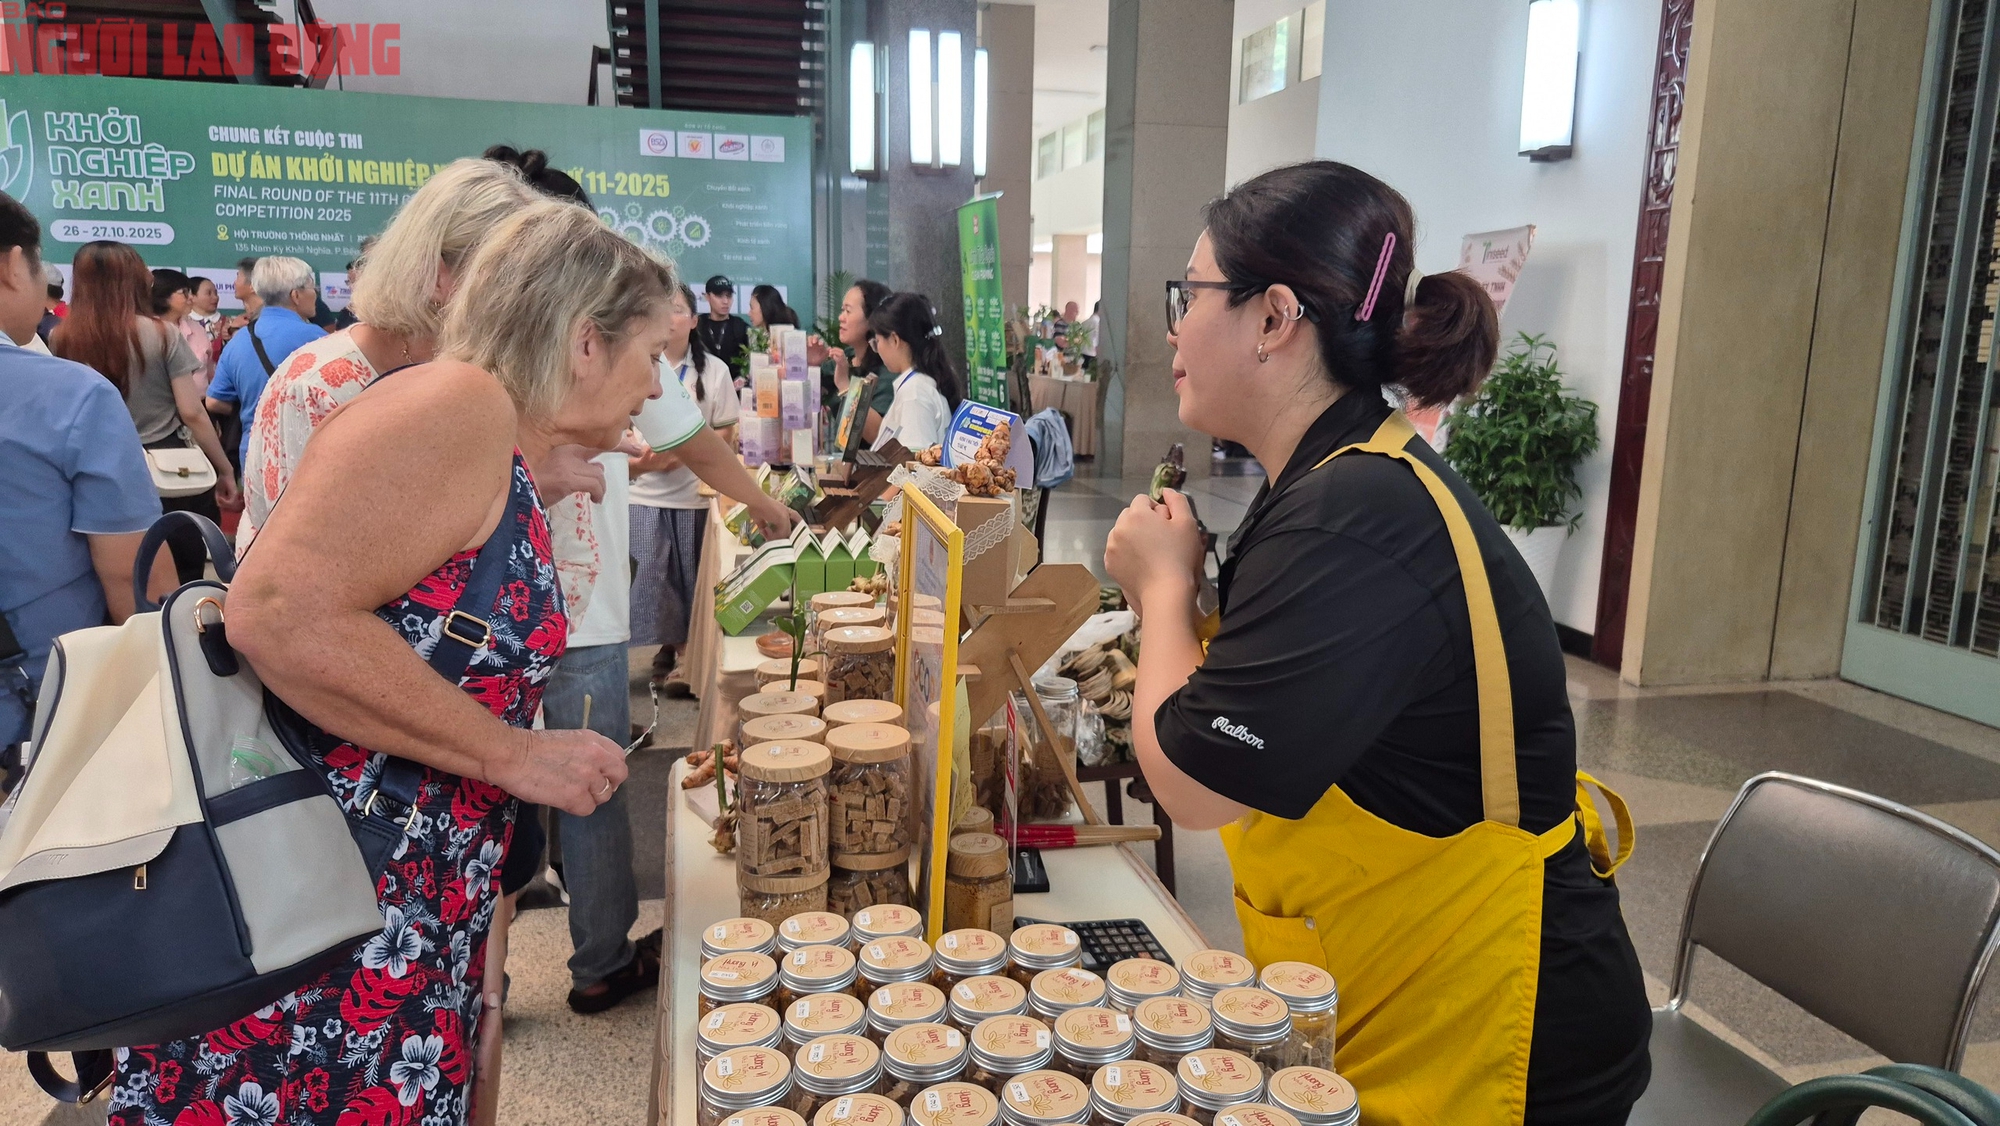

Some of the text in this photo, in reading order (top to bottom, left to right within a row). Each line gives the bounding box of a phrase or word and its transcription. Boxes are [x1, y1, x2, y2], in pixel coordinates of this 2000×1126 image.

[45, 106, 142, 145] KHỞI
[208, 124, 363, 150] CHUNG KẾT CUỘC THI
[48, 142, 196, 187] NGHIỆP
[211, 150, 431, 190] DỰ ÁN KHỞI NGHIỆP
[52, 179, 165, 212] XANH
[214, 184, 258, 201] FINAL
[261, 187, 312, 202] ROUND
[315, 190, 335, 203] OF
[337, 191, 366, 205] THE
[369, 192, 398, 205] 11TH
[585, 170, 670, 198] 11-2025
[215, 202, 352, 222] COMPETITION 2025
[63, 225, 80, 237] 26
[92, 226, 163, 239] 27.10.2025
[233, 229, 250, 241] HỘI
[251, 229, 288, 241] TRƯỜNG
[289, 230, 320, 242] THỐNG
[251, 243, 271, 253] Nam
[1211, 715, 1265, 750] Malbon
